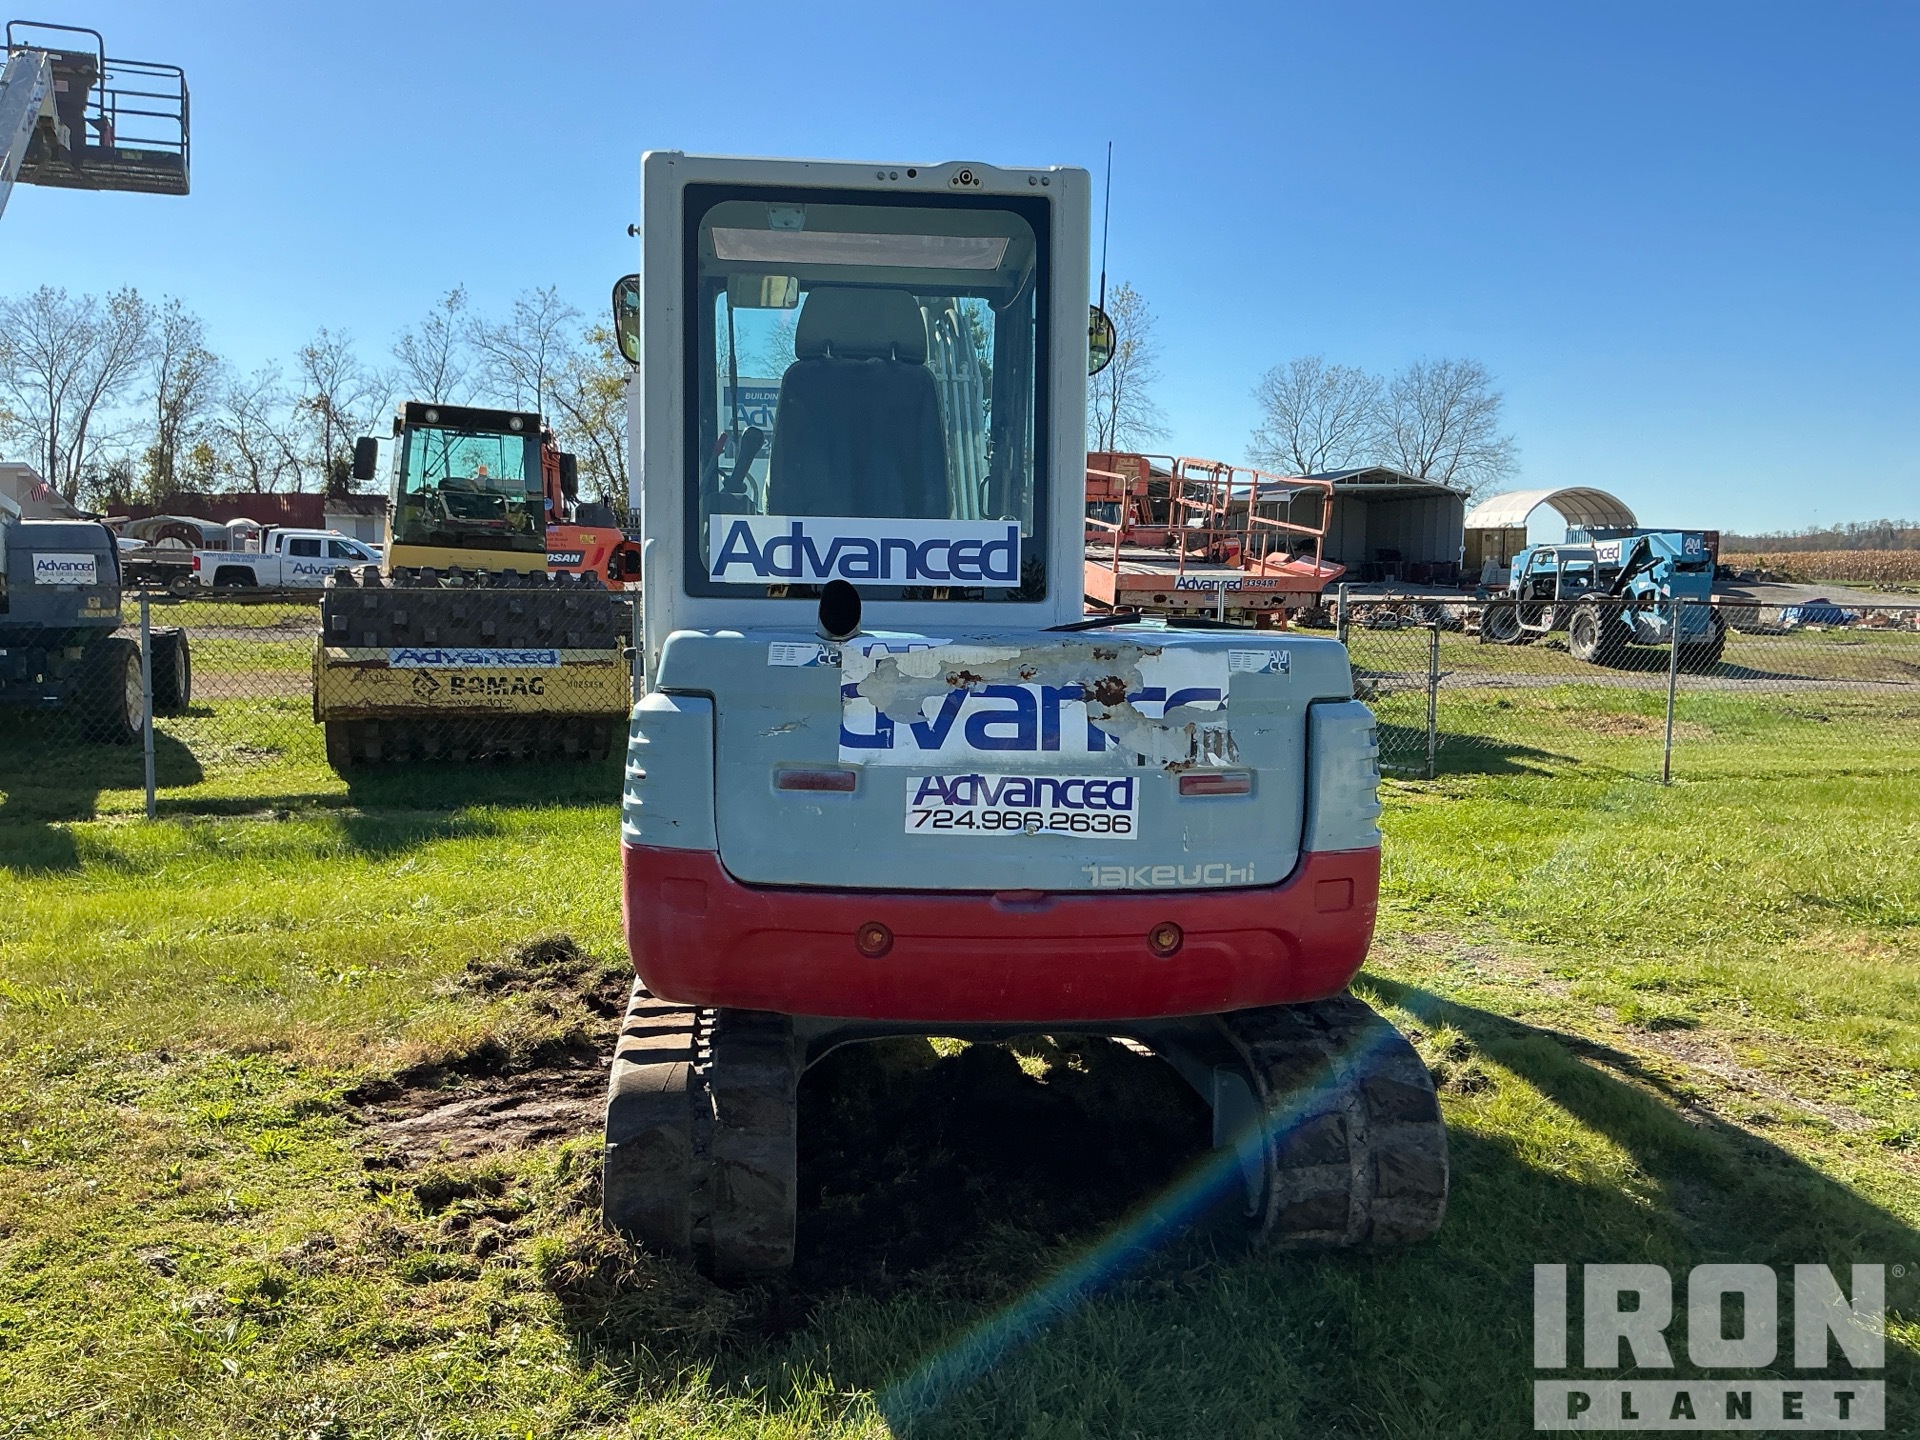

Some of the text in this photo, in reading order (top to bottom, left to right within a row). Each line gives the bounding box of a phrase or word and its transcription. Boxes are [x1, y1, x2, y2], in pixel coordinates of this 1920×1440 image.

[711, 520, 1019, 582] Advanced
[37, 560, 95, 571] Advanced
[1245, 579, 1279, 588] 3394RT
[393, 649, 556, 665] Advanced
[1269, 650, 1287, 663] AM
[451, 677, 545, 696] BOMAG
[912, 773, 1134, 811] Advanced
[911, 809, 1132, 834] 724.966.2636
